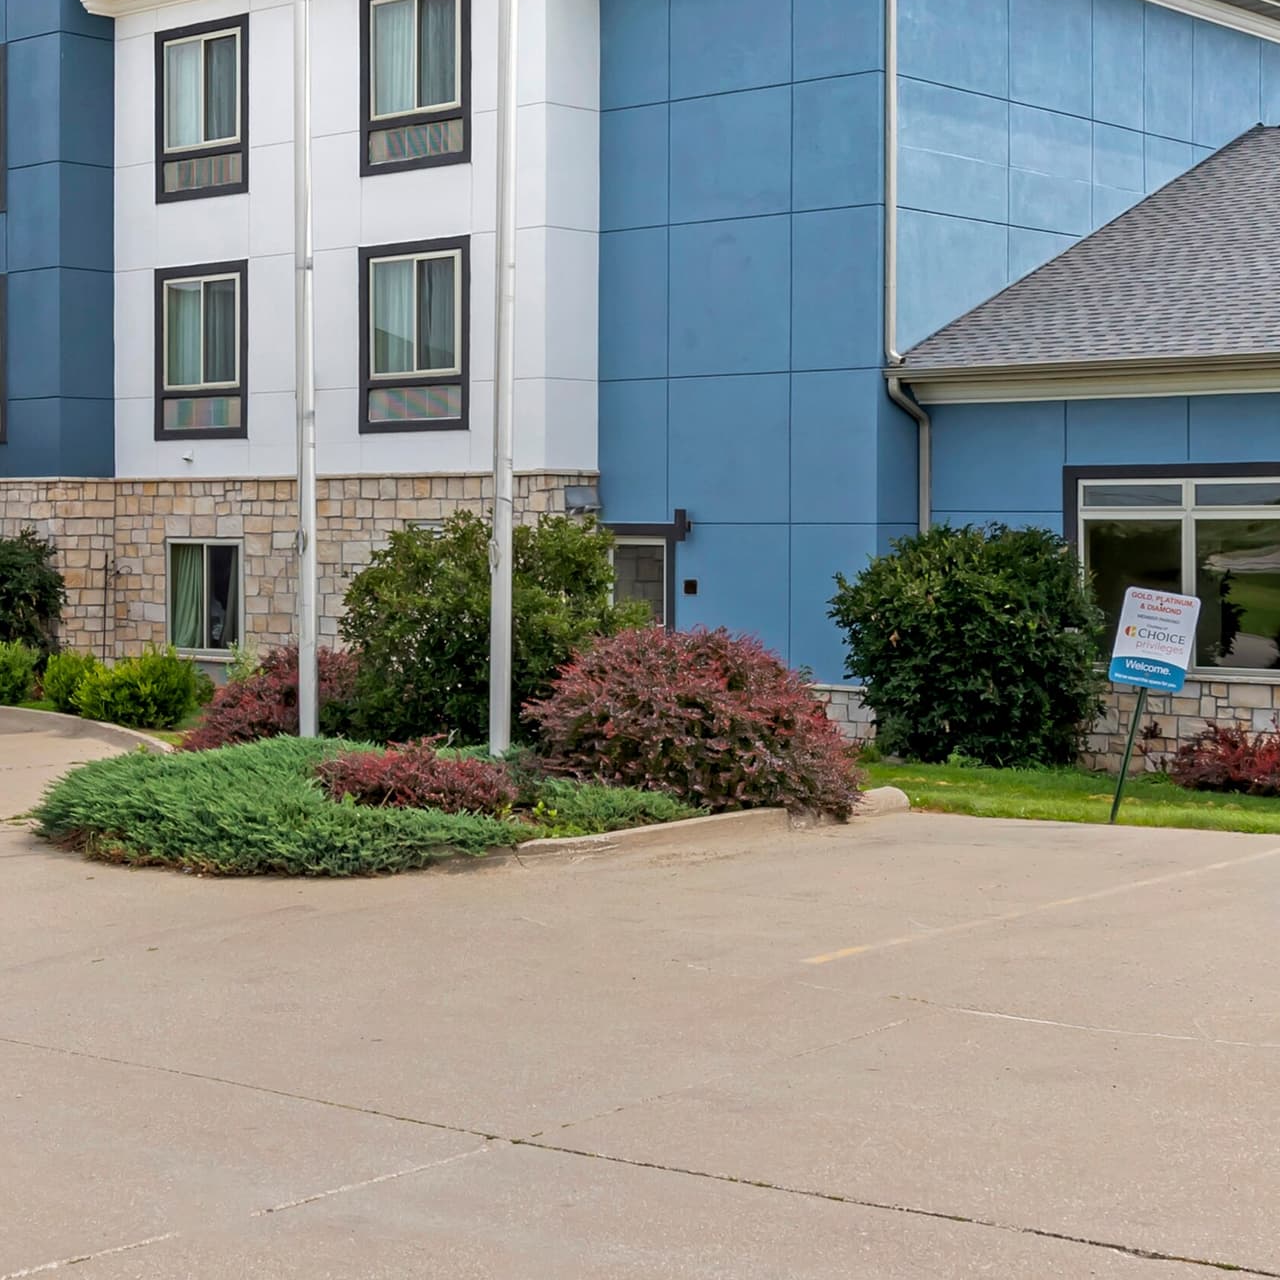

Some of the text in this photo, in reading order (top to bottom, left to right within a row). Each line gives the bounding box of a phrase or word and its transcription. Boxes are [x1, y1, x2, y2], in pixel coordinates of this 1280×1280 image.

[1146, 604, 1183, 616] DIAMOND
[1138, 628, 1187, 645] CHOICE
[1135, 640, 1185, 656] privileges
[1125, 658, 1172, 676] Welcome.
